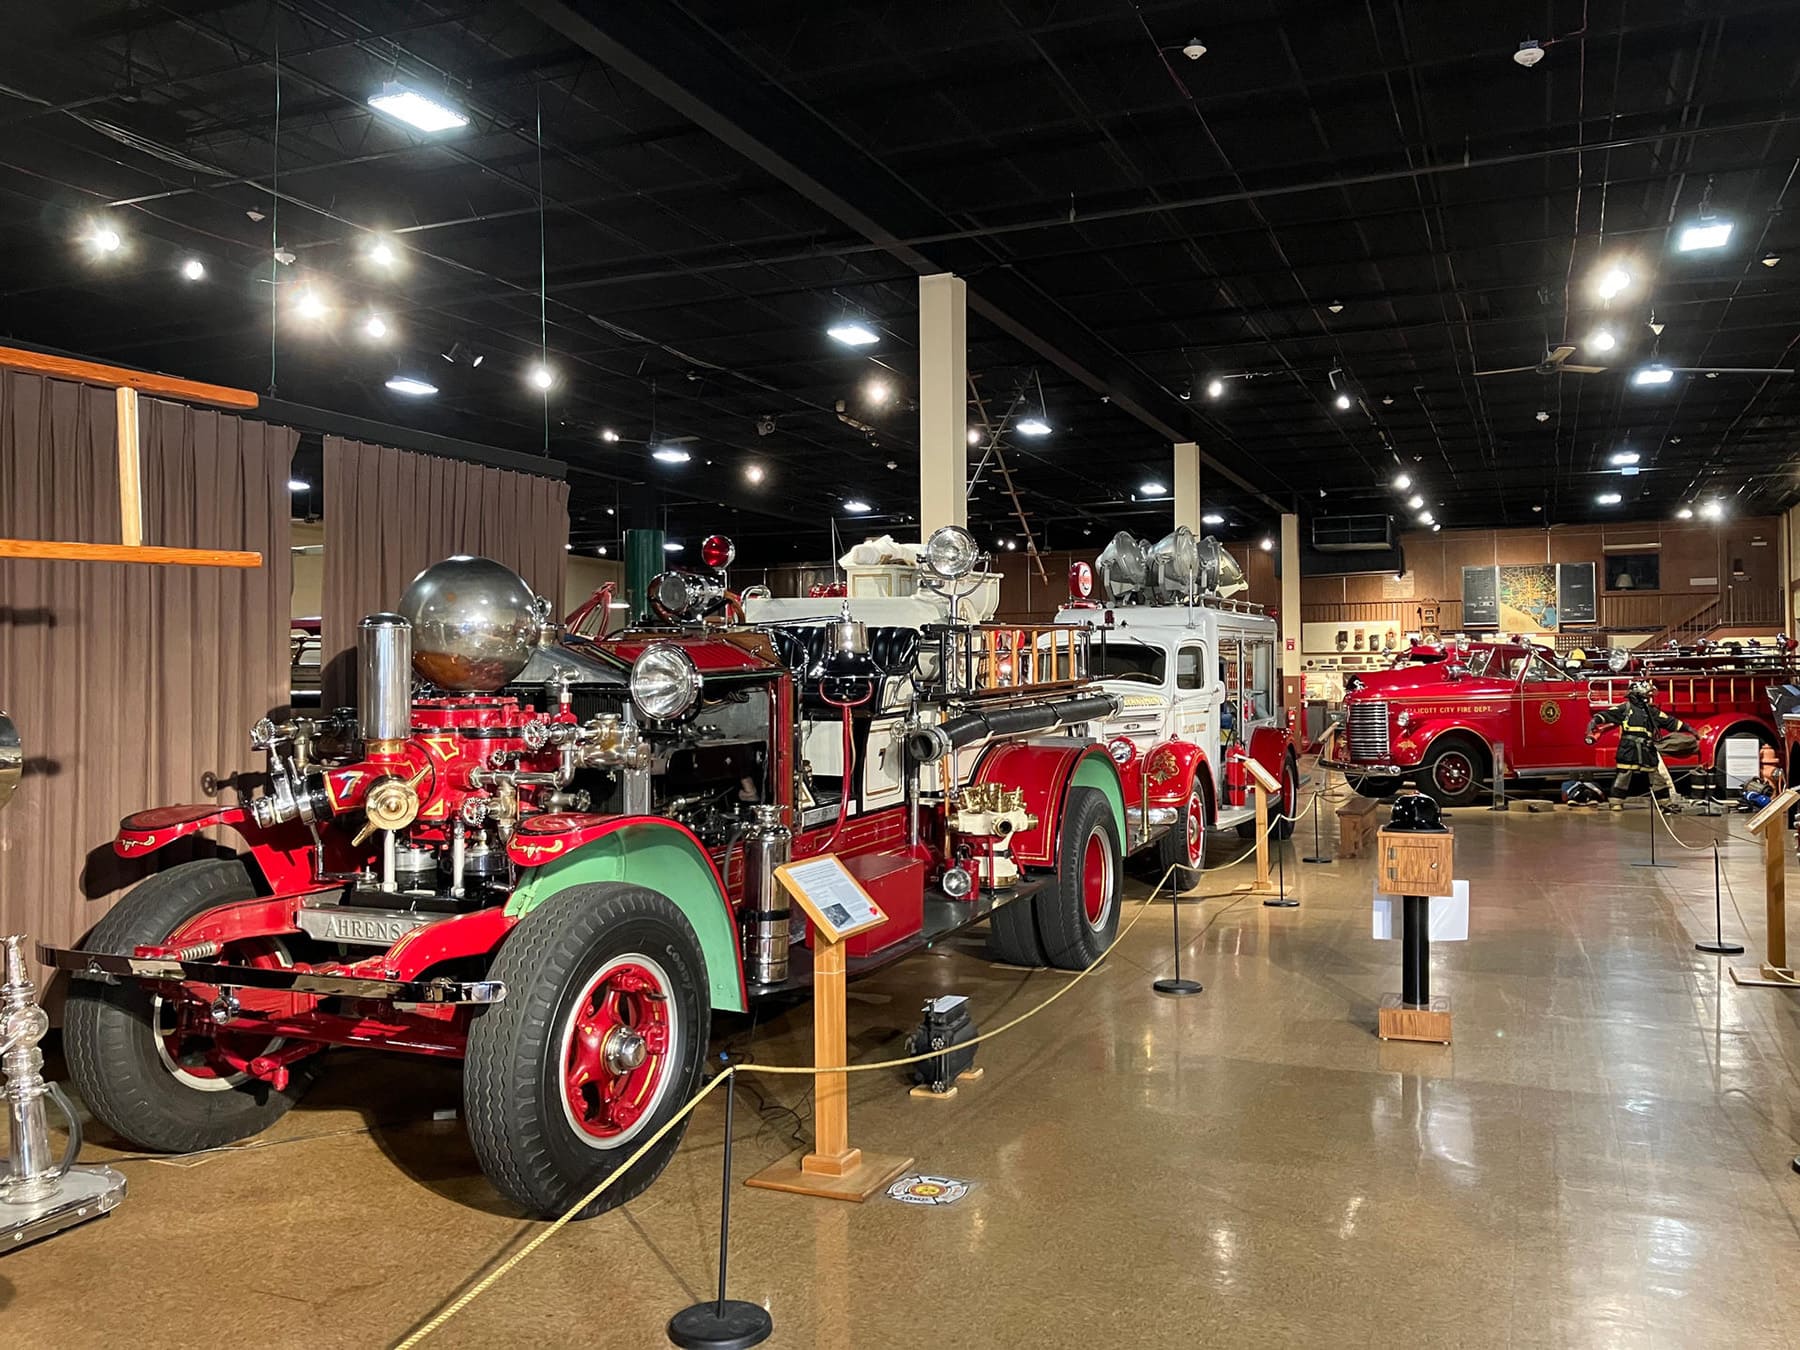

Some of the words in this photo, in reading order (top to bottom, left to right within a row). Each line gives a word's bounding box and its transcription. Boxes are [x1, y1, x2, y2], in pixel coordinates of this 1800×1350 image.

[1440, 706, 1455, 714] CITY
[1457, 705, 1472, 713] FIRE
[336, 770, 364, 799] 7
[324, 914, 401, 940] AHRENS
